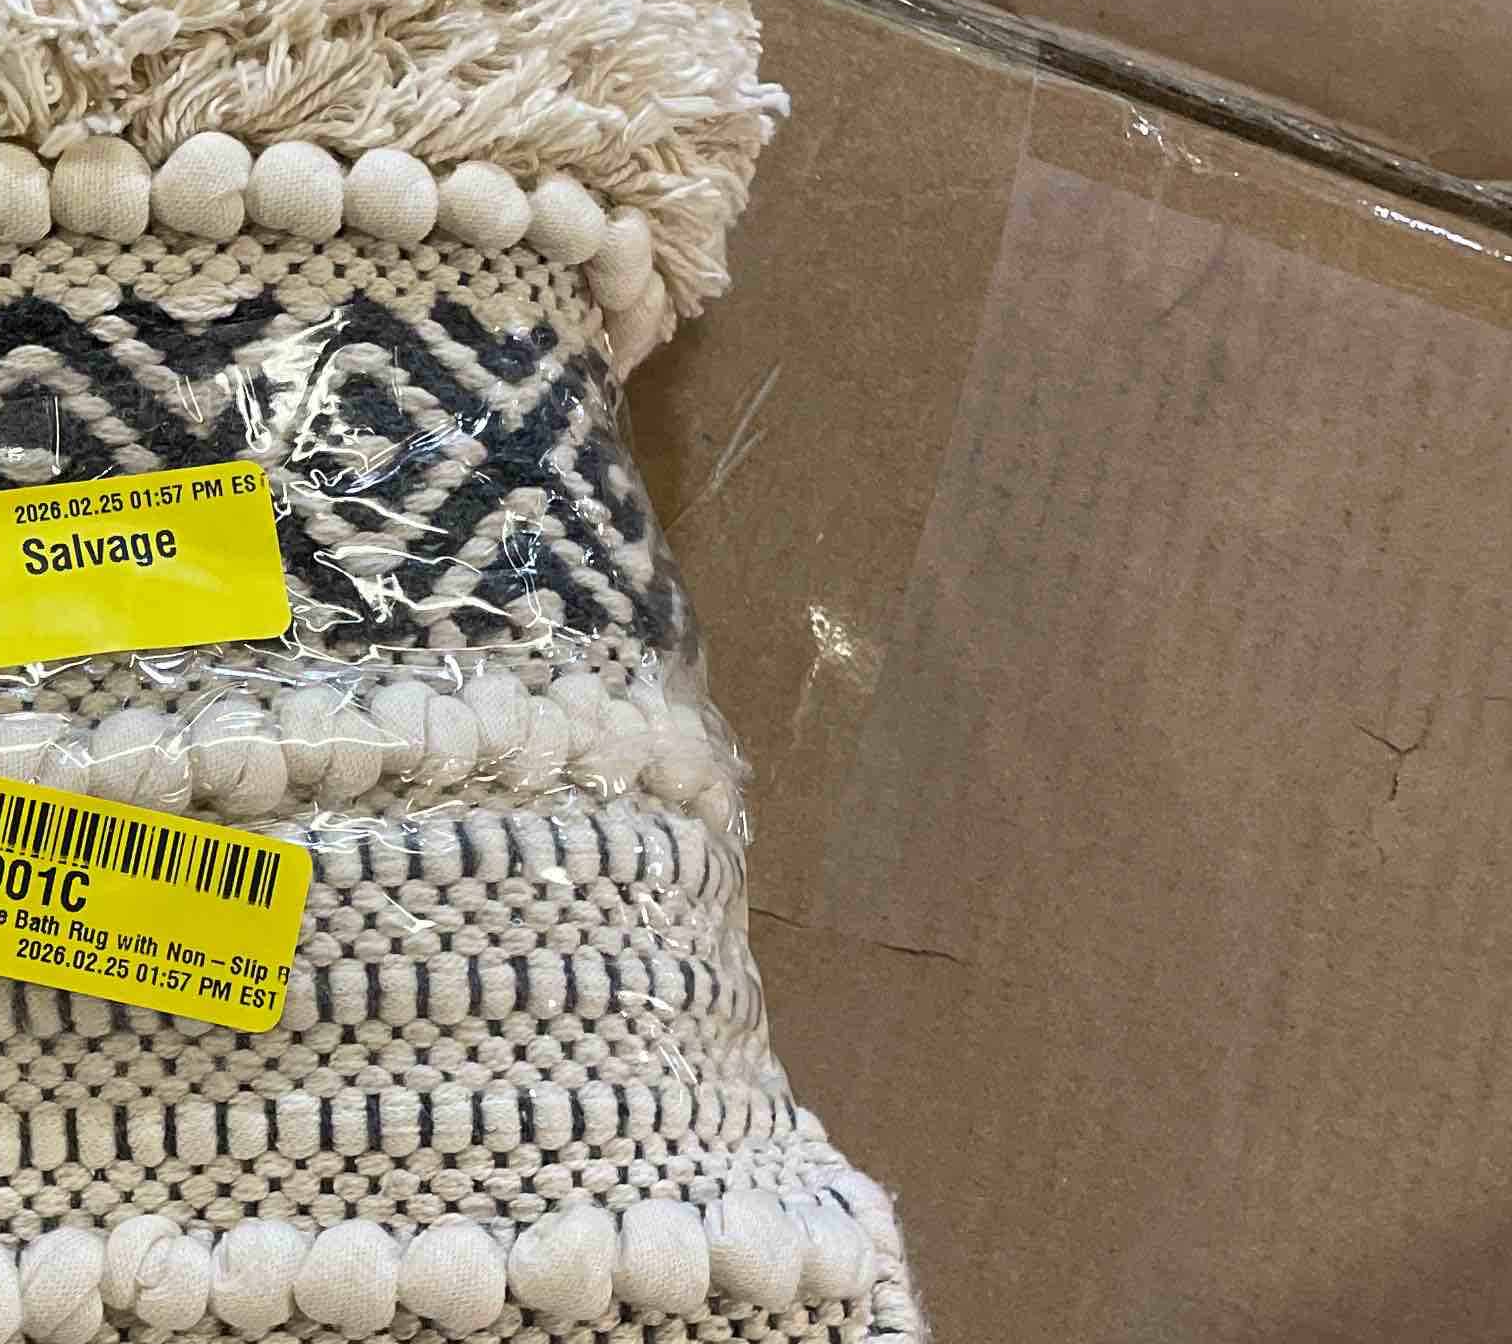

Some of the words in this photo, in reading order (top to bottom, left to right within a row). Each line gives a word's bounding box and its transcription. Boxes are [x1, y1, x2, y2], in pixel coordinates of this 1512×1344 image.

[14, 492, 124, 524] 2026.02.25
[129, 484, 183, 509] 01:57
[191, 478, 223, 501] PM
[22, 529, 177, 575] Salvage
[14, 908, 60, 937] Bath
[68, 919, 109, 951] Rug
[117, 934, 158, 957] with
[16, 938, 130, 979] 2026.02.25
[135, 963, 192, 992] 01:57
[198, 976, 233, 1002] PM
[239, 985, 277, 1011] EST
